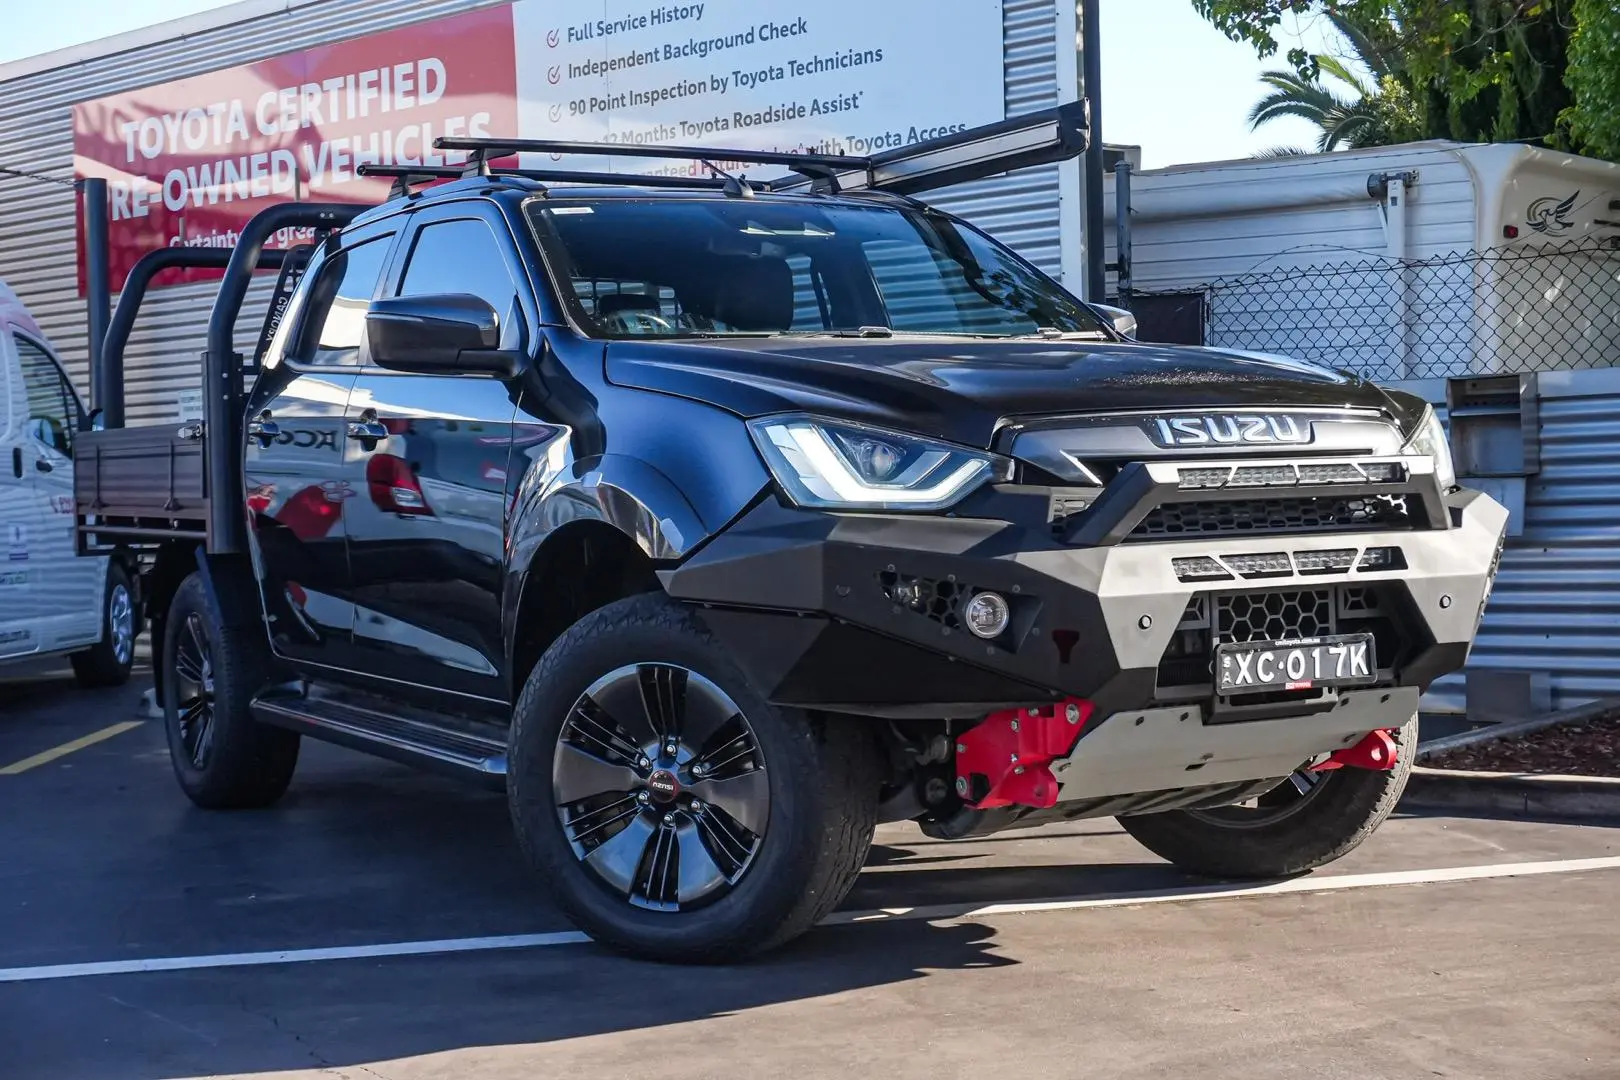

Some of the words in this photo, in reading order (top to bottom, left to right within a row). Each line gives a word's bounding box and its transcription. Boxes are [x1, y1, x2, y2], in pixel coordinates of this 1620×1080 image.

[568, 22, 593, 43] Full
[596, 14, 648, 37] Service
[650, 3, 704, 26] History
[568, 48, 660, 79] Independent
[663, 26, 755, 61] Background
[758, 16, 808, 43] Check
[569, 99, 586, 117] 90
[589, 93, 626, 113] Point
[629, 79, 707, 107] Inspection
[710, 74, 729, 94] by
[732, 65, 785, 90] Toyota
[787, 48, 884, 78] Technicians
[122, 99, 250, 163] TOYOTA
[255, 57, 447, 136] CERTIFIED
[621, 124, 676, 145] Months
[679, 116, 730, 139] Toyota
[733, 101, 806, 129] Roadside
[845, 131, 901, 155] Toyota
[906, 123, 966, 145] Access
[108, 149, 297, 221] RE-OWNED
[303, 111, 492, 188] VEHICLES
[1155, 415, 1301, 445] ISUZU
